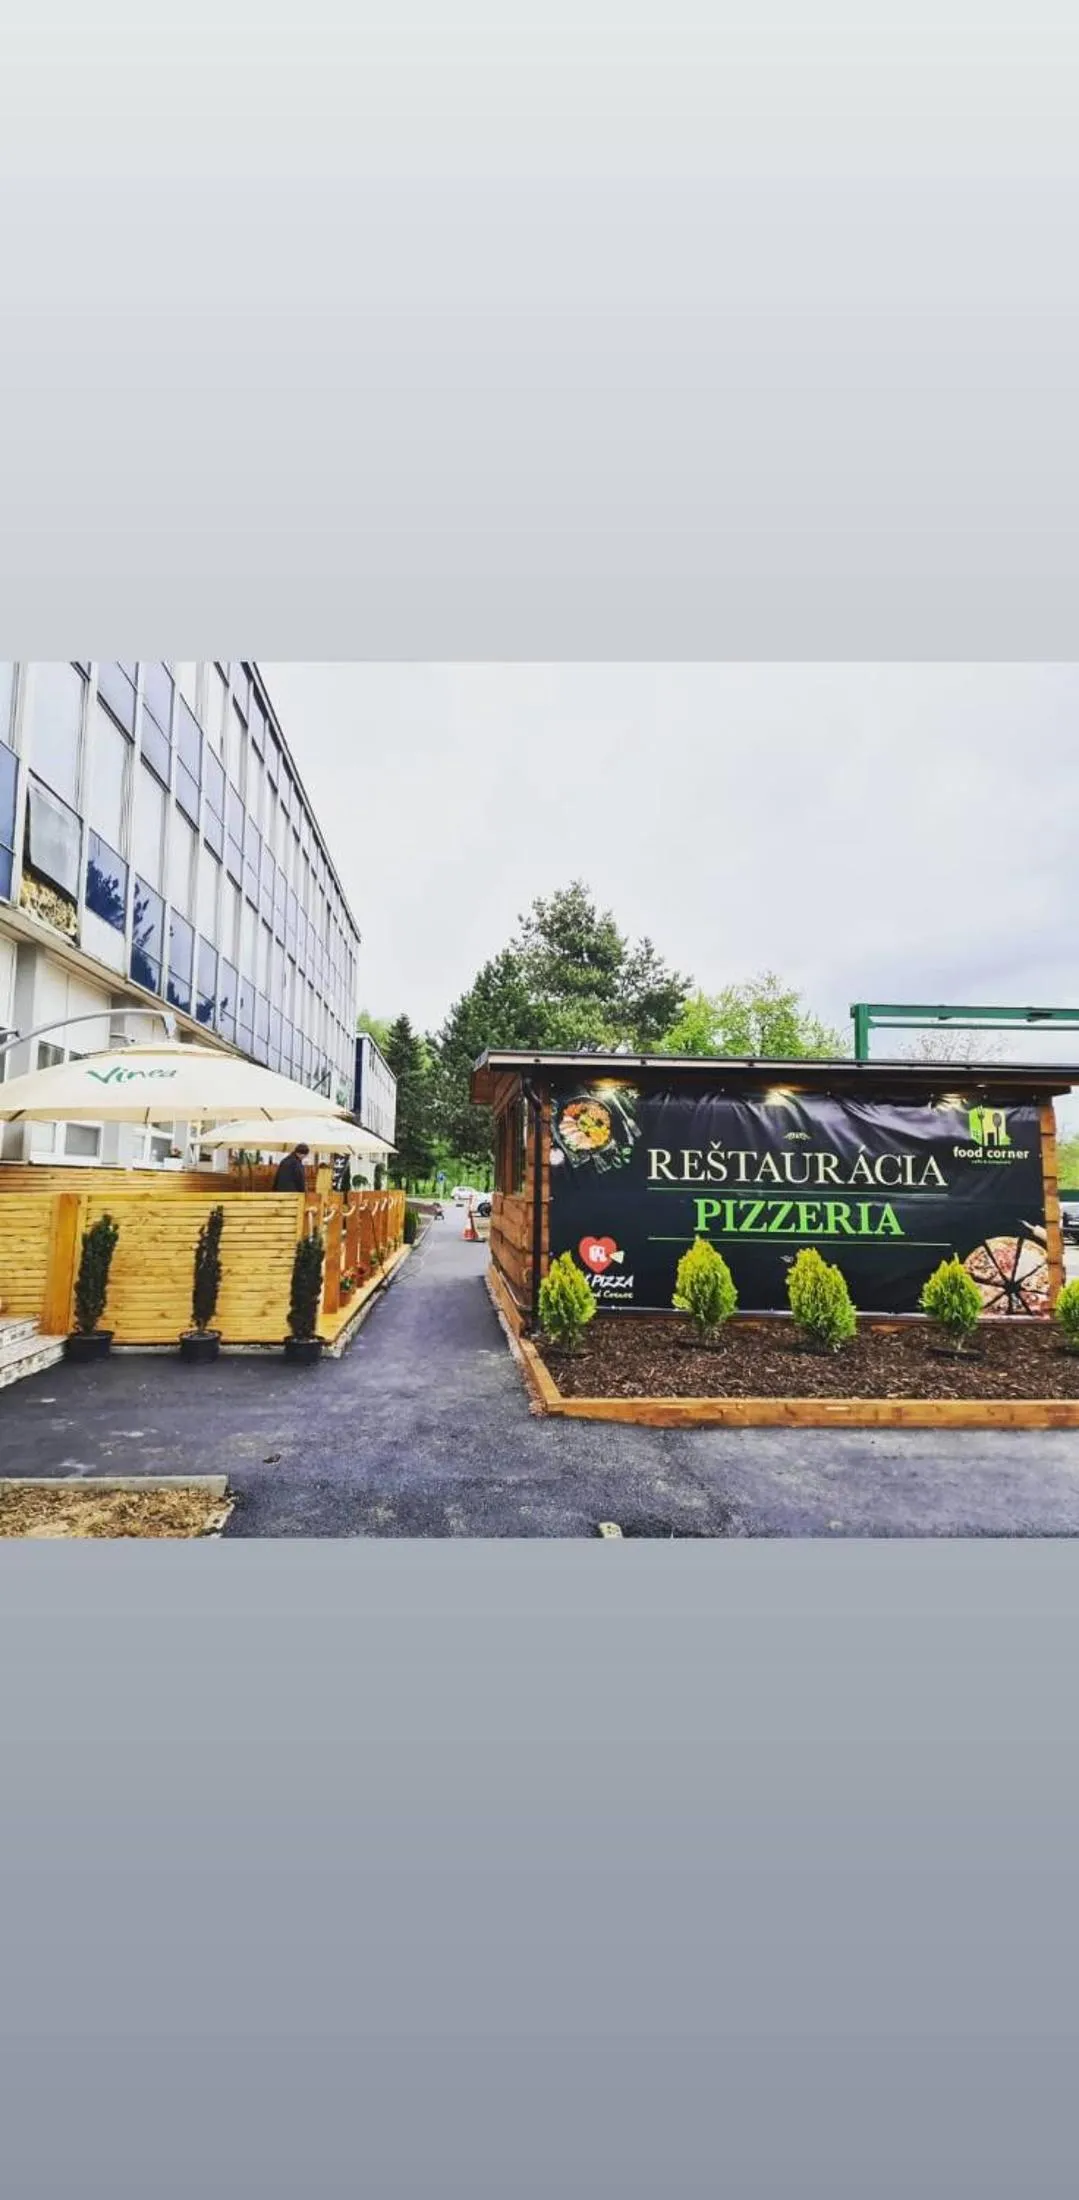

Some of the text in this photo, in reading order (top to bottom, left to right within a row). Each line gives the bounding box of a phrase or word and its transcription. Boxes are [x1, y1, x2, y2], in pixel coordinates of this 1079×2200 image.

[85, 1066, 177, 1084] Vinea
[953, 1146, 1030, 1159] food corner
[647, 1141, 948, 1186] REŠTAURÁCIA
[693, 1198, 905, 1235] PIZZERIA
[591, 1274, 634, 1288] PIZZA
